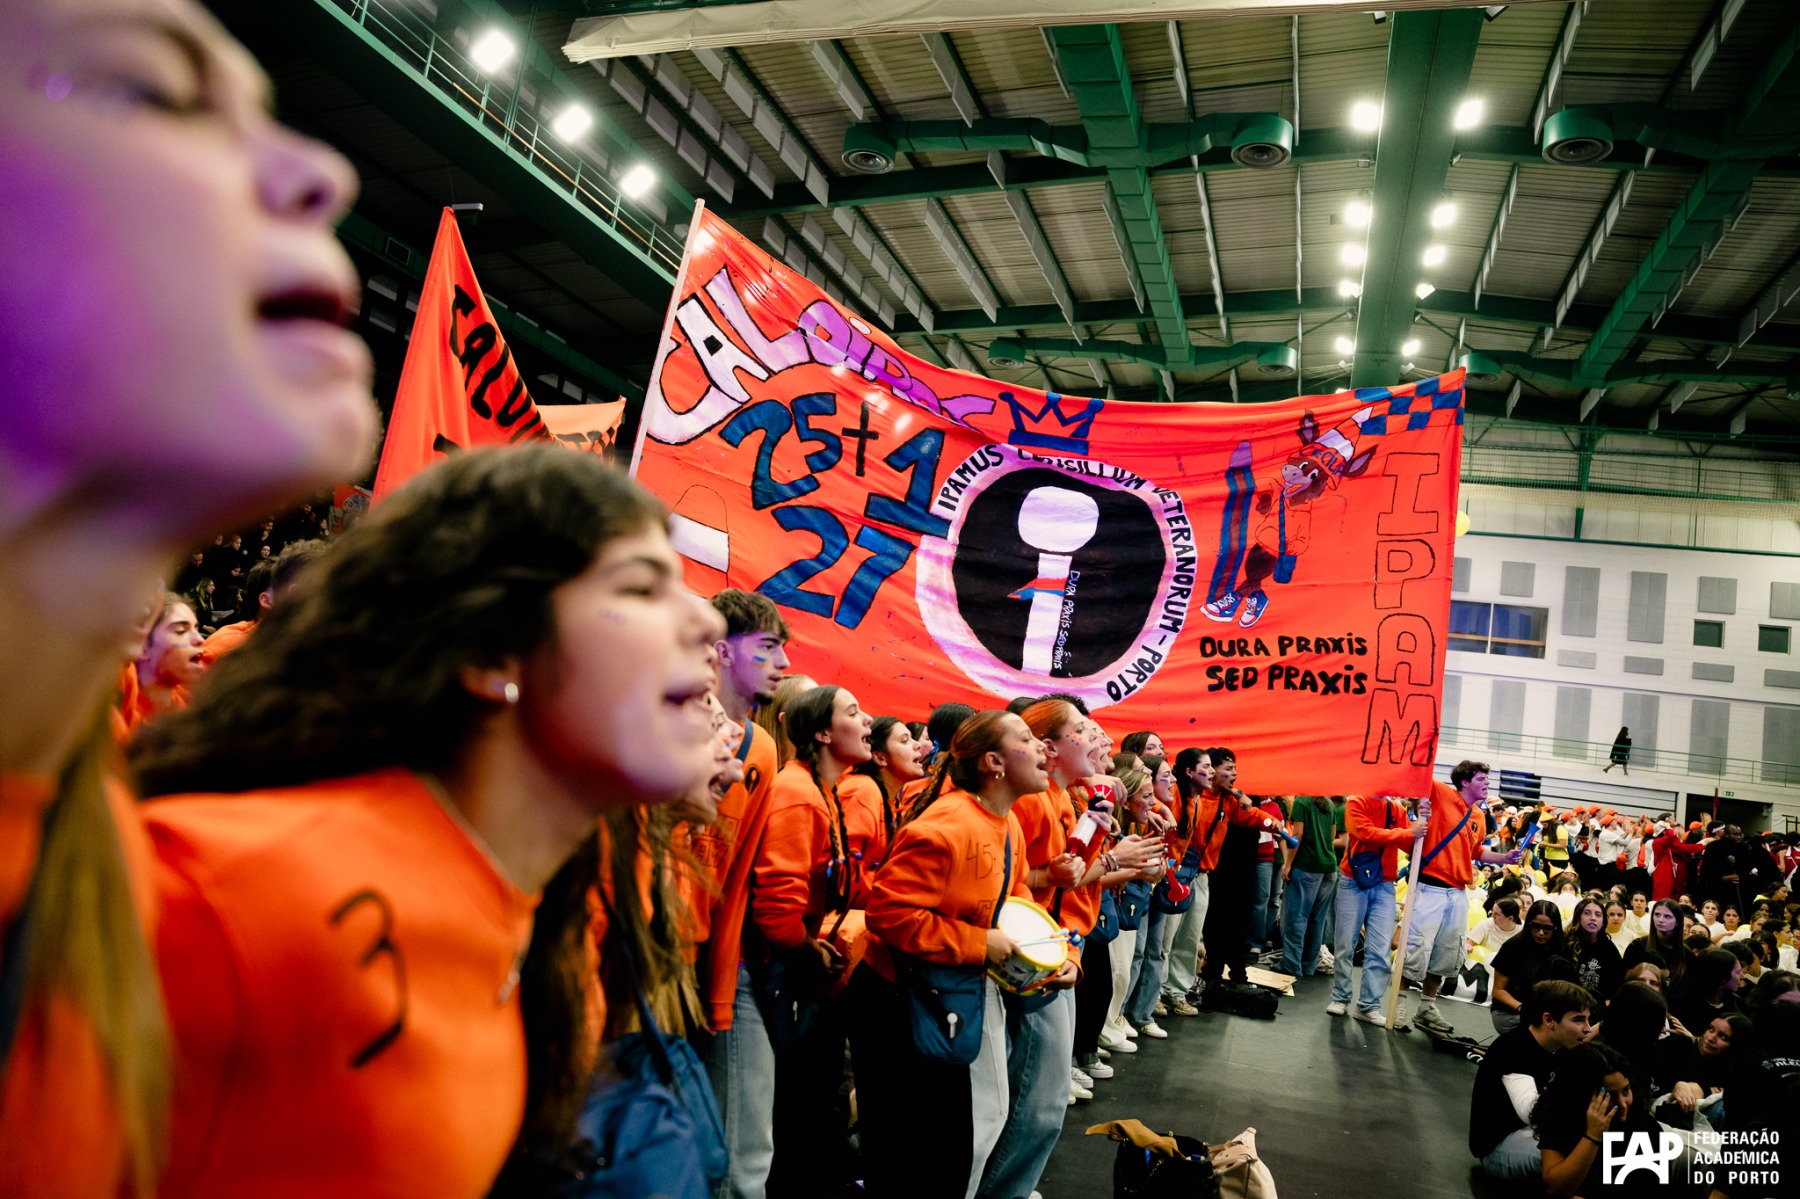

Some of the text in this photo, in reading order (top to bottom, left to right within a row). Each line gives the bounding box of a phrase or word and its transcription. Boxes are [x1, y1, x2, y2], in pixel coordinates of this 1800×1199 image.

[937, 444, 1004, 512] IPAMUS
[754, 504, 917, 631] 27
[1152, 486, 1199, 634] VETERANORUM
[1360, 451, 1441, 766] IPAM
[1107, 644, 1164, 702] PORTO
[1199, 636, 1272, 658] DURA
[1205, 664, 1259, 692] SED
